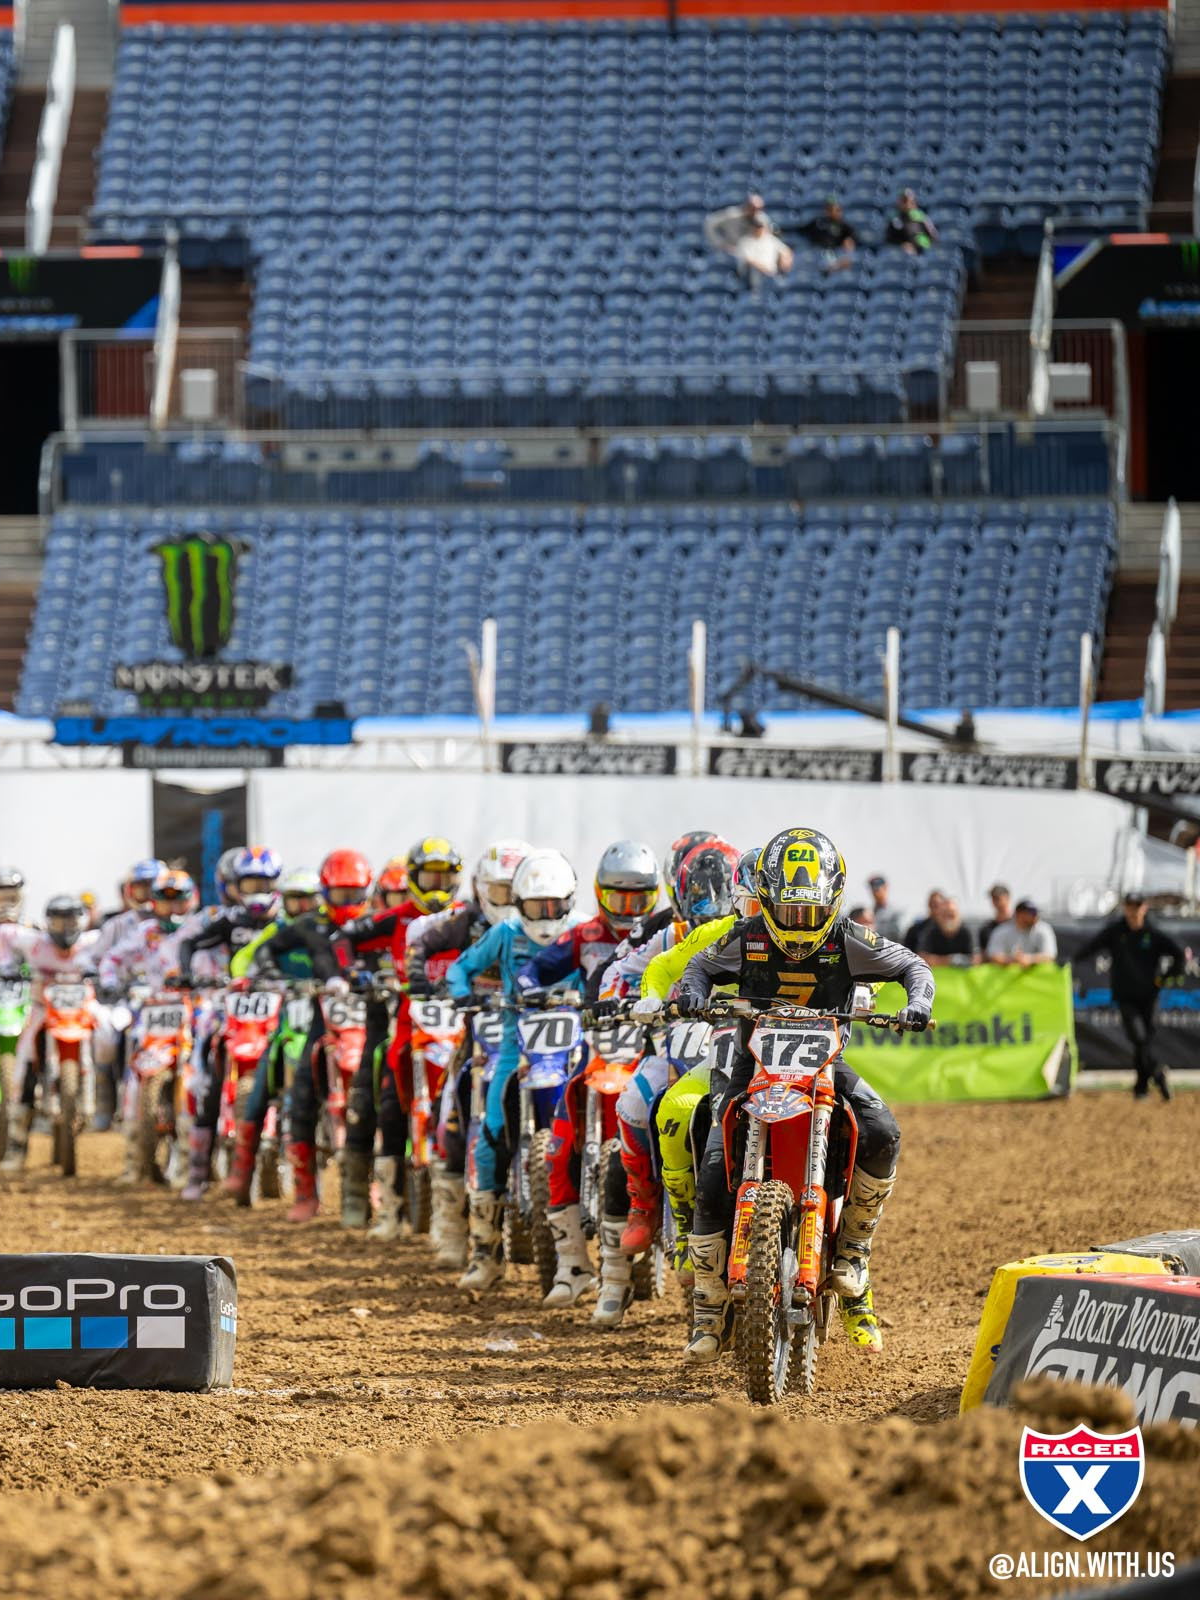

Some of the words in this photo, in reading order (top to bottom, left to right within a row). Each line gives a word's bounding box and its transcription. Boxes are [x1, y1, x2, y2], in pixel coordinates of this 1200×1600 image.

[524, 1018, 573, 1050] 70
[760, 1033, 831, 1068] 173
[811, 1118, 823, 1172] WORKS
[1062, 1289, 1128, 1345] ROCKY
[1117, 1296, 1200, 1362] MOUNTA
